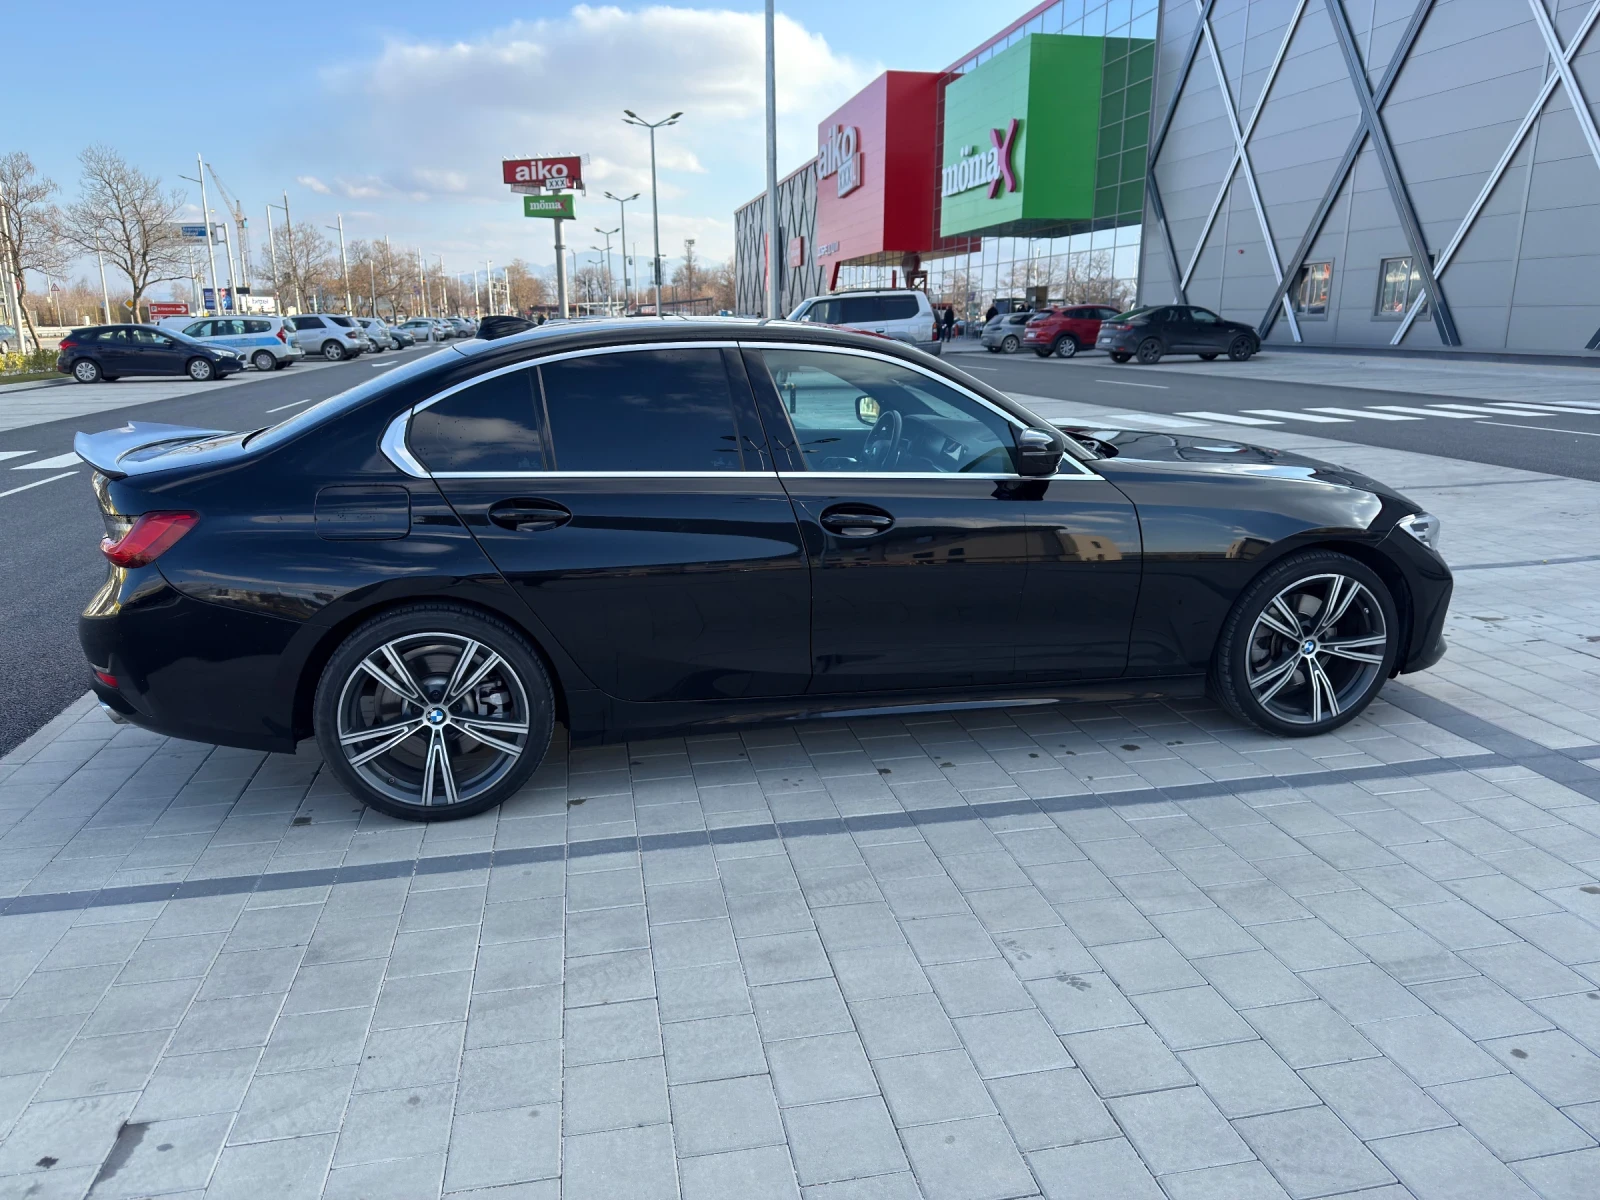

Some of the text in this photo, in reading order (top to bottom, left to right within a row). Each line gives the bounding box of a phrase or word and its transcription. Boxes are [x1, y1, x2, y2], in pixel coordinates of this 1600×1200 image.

[818, 124, 857, 180] aiko
[515, 160, 568, 181] aiko
[548, 178, 572, 188] XXXL
